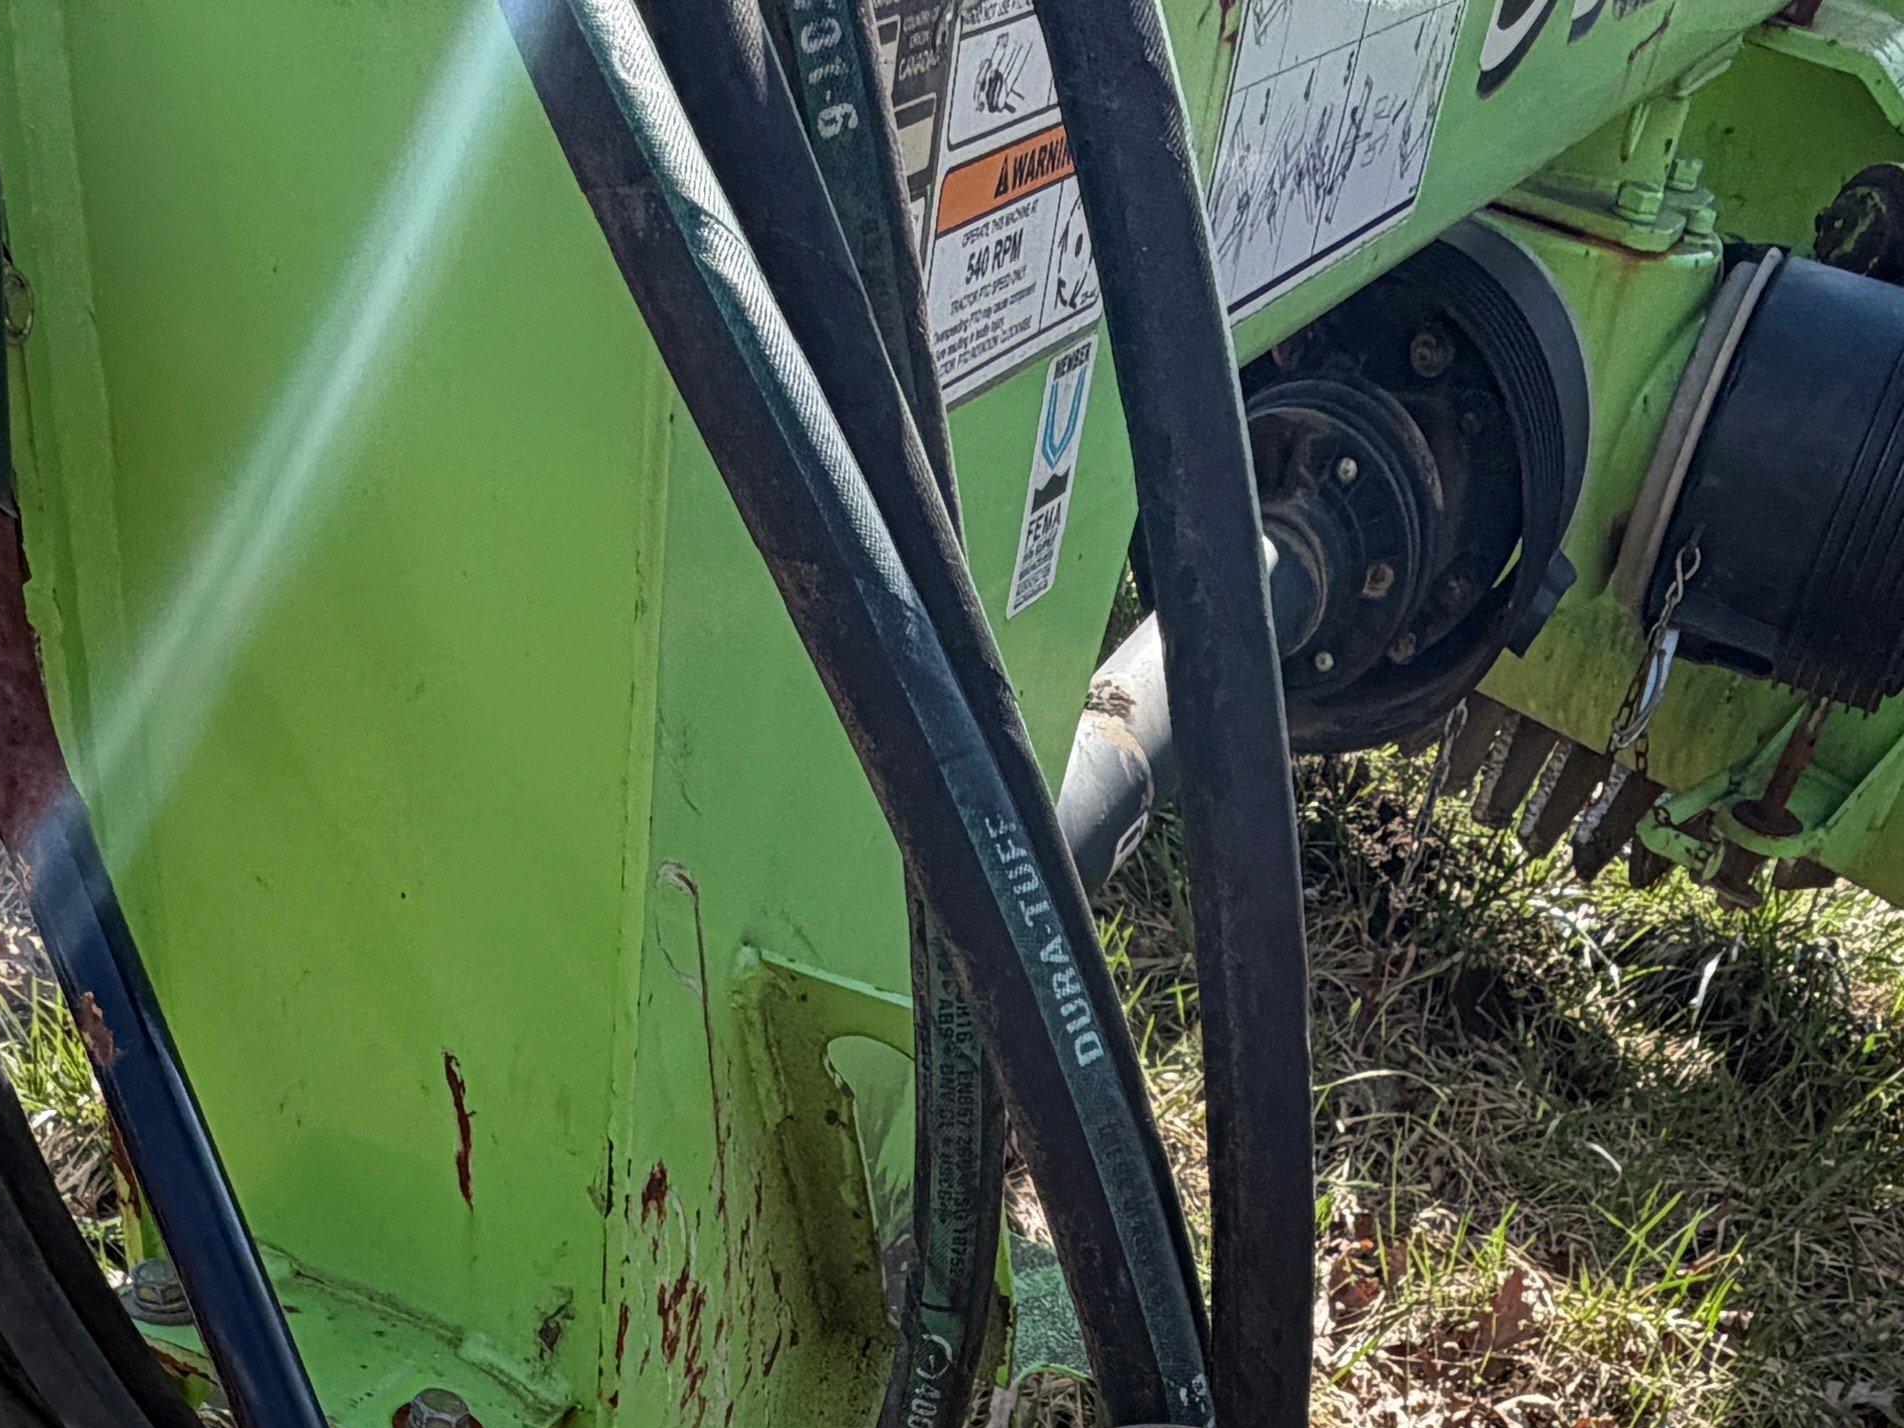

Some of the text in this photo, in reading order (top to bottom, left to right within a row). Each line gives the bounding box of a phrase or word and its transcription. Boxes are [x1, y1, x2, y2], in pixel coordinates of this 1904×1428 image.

[1011, 136, 1071, 191] WARNIN
[965, 226, 1025, 285] 540 RPM
[1052, 341, 1092, 381] MEMBER
[1026, 501, 1062, 548] FEMA
[983, 808, 1107, 1068] DURA-TUFF
